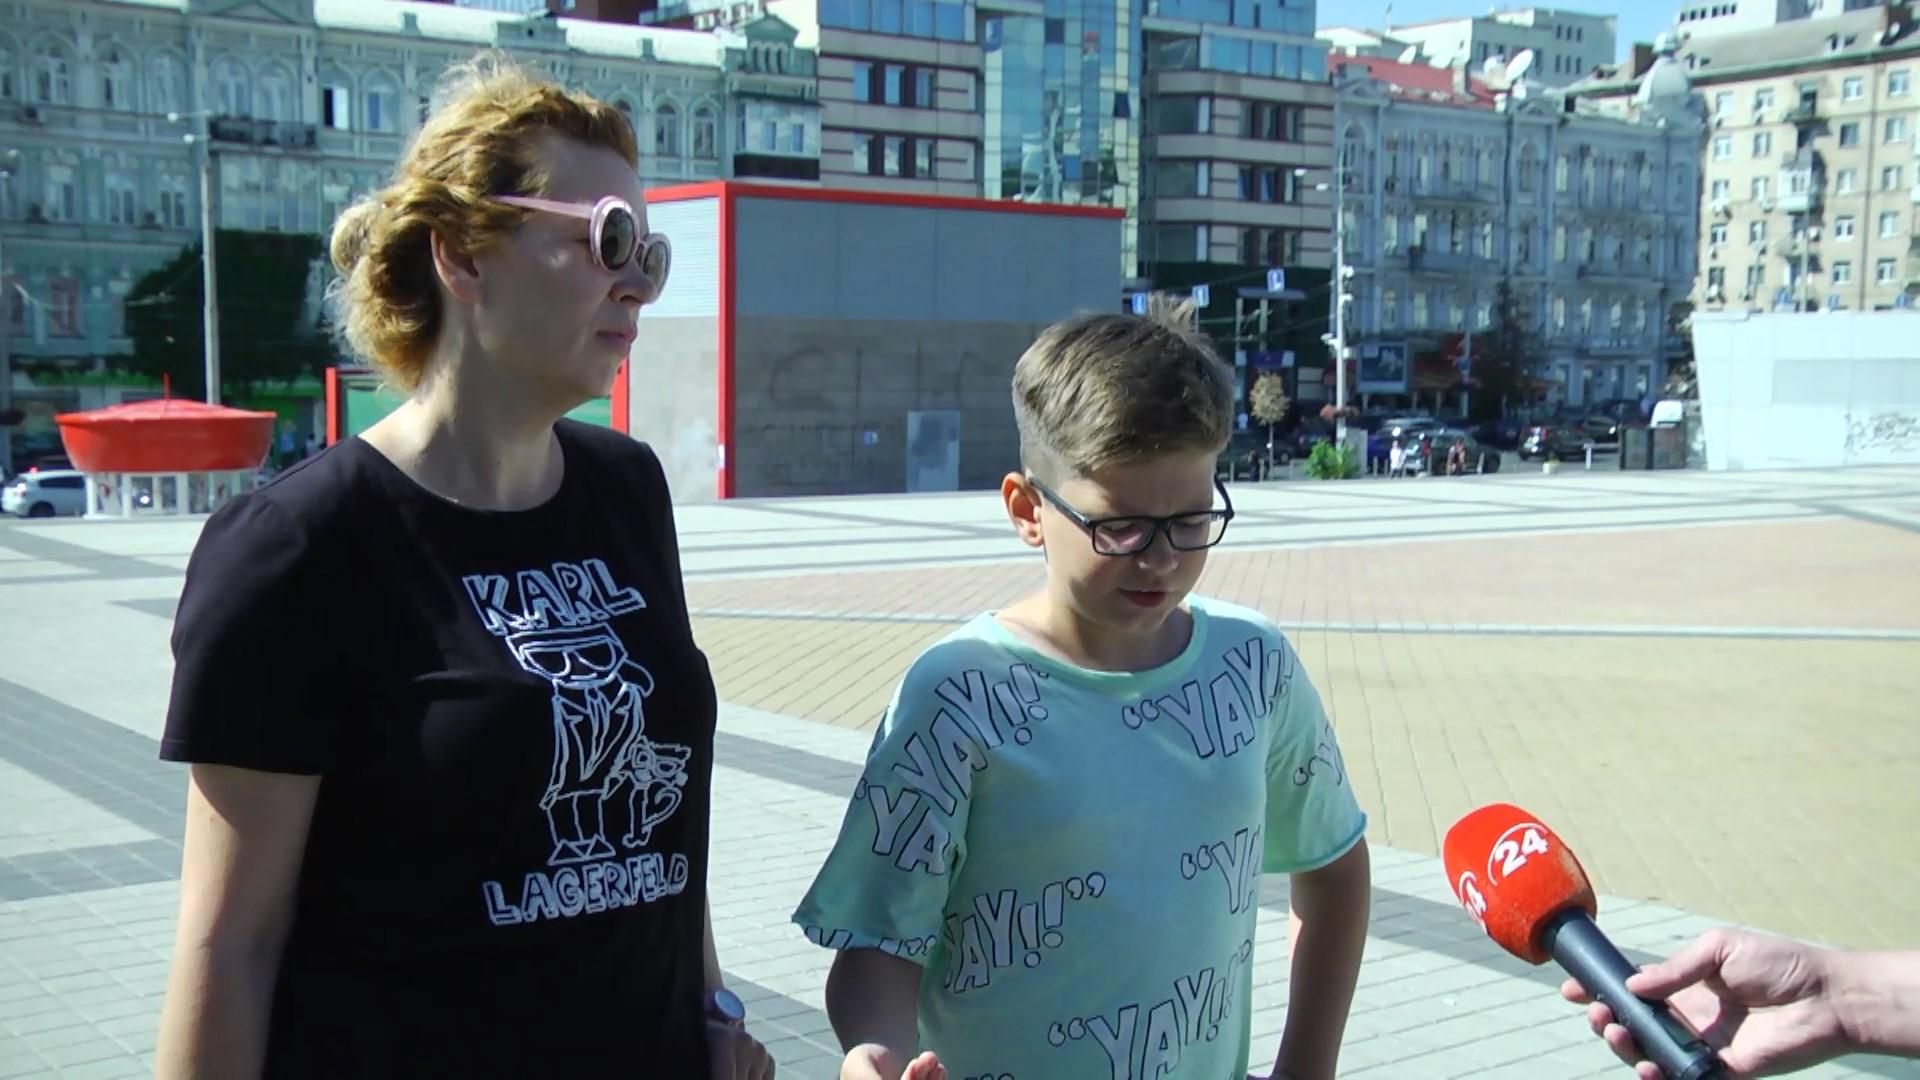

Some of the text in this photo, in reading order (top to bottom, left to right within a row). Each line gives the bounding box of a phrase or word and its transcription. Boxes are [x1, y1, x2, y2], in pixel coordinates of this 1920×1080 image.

[462, 558, 647, 636] KARL
[482, 853, 689, 926] LAGERFELD
[1494, 828, 1550, 879] 24
